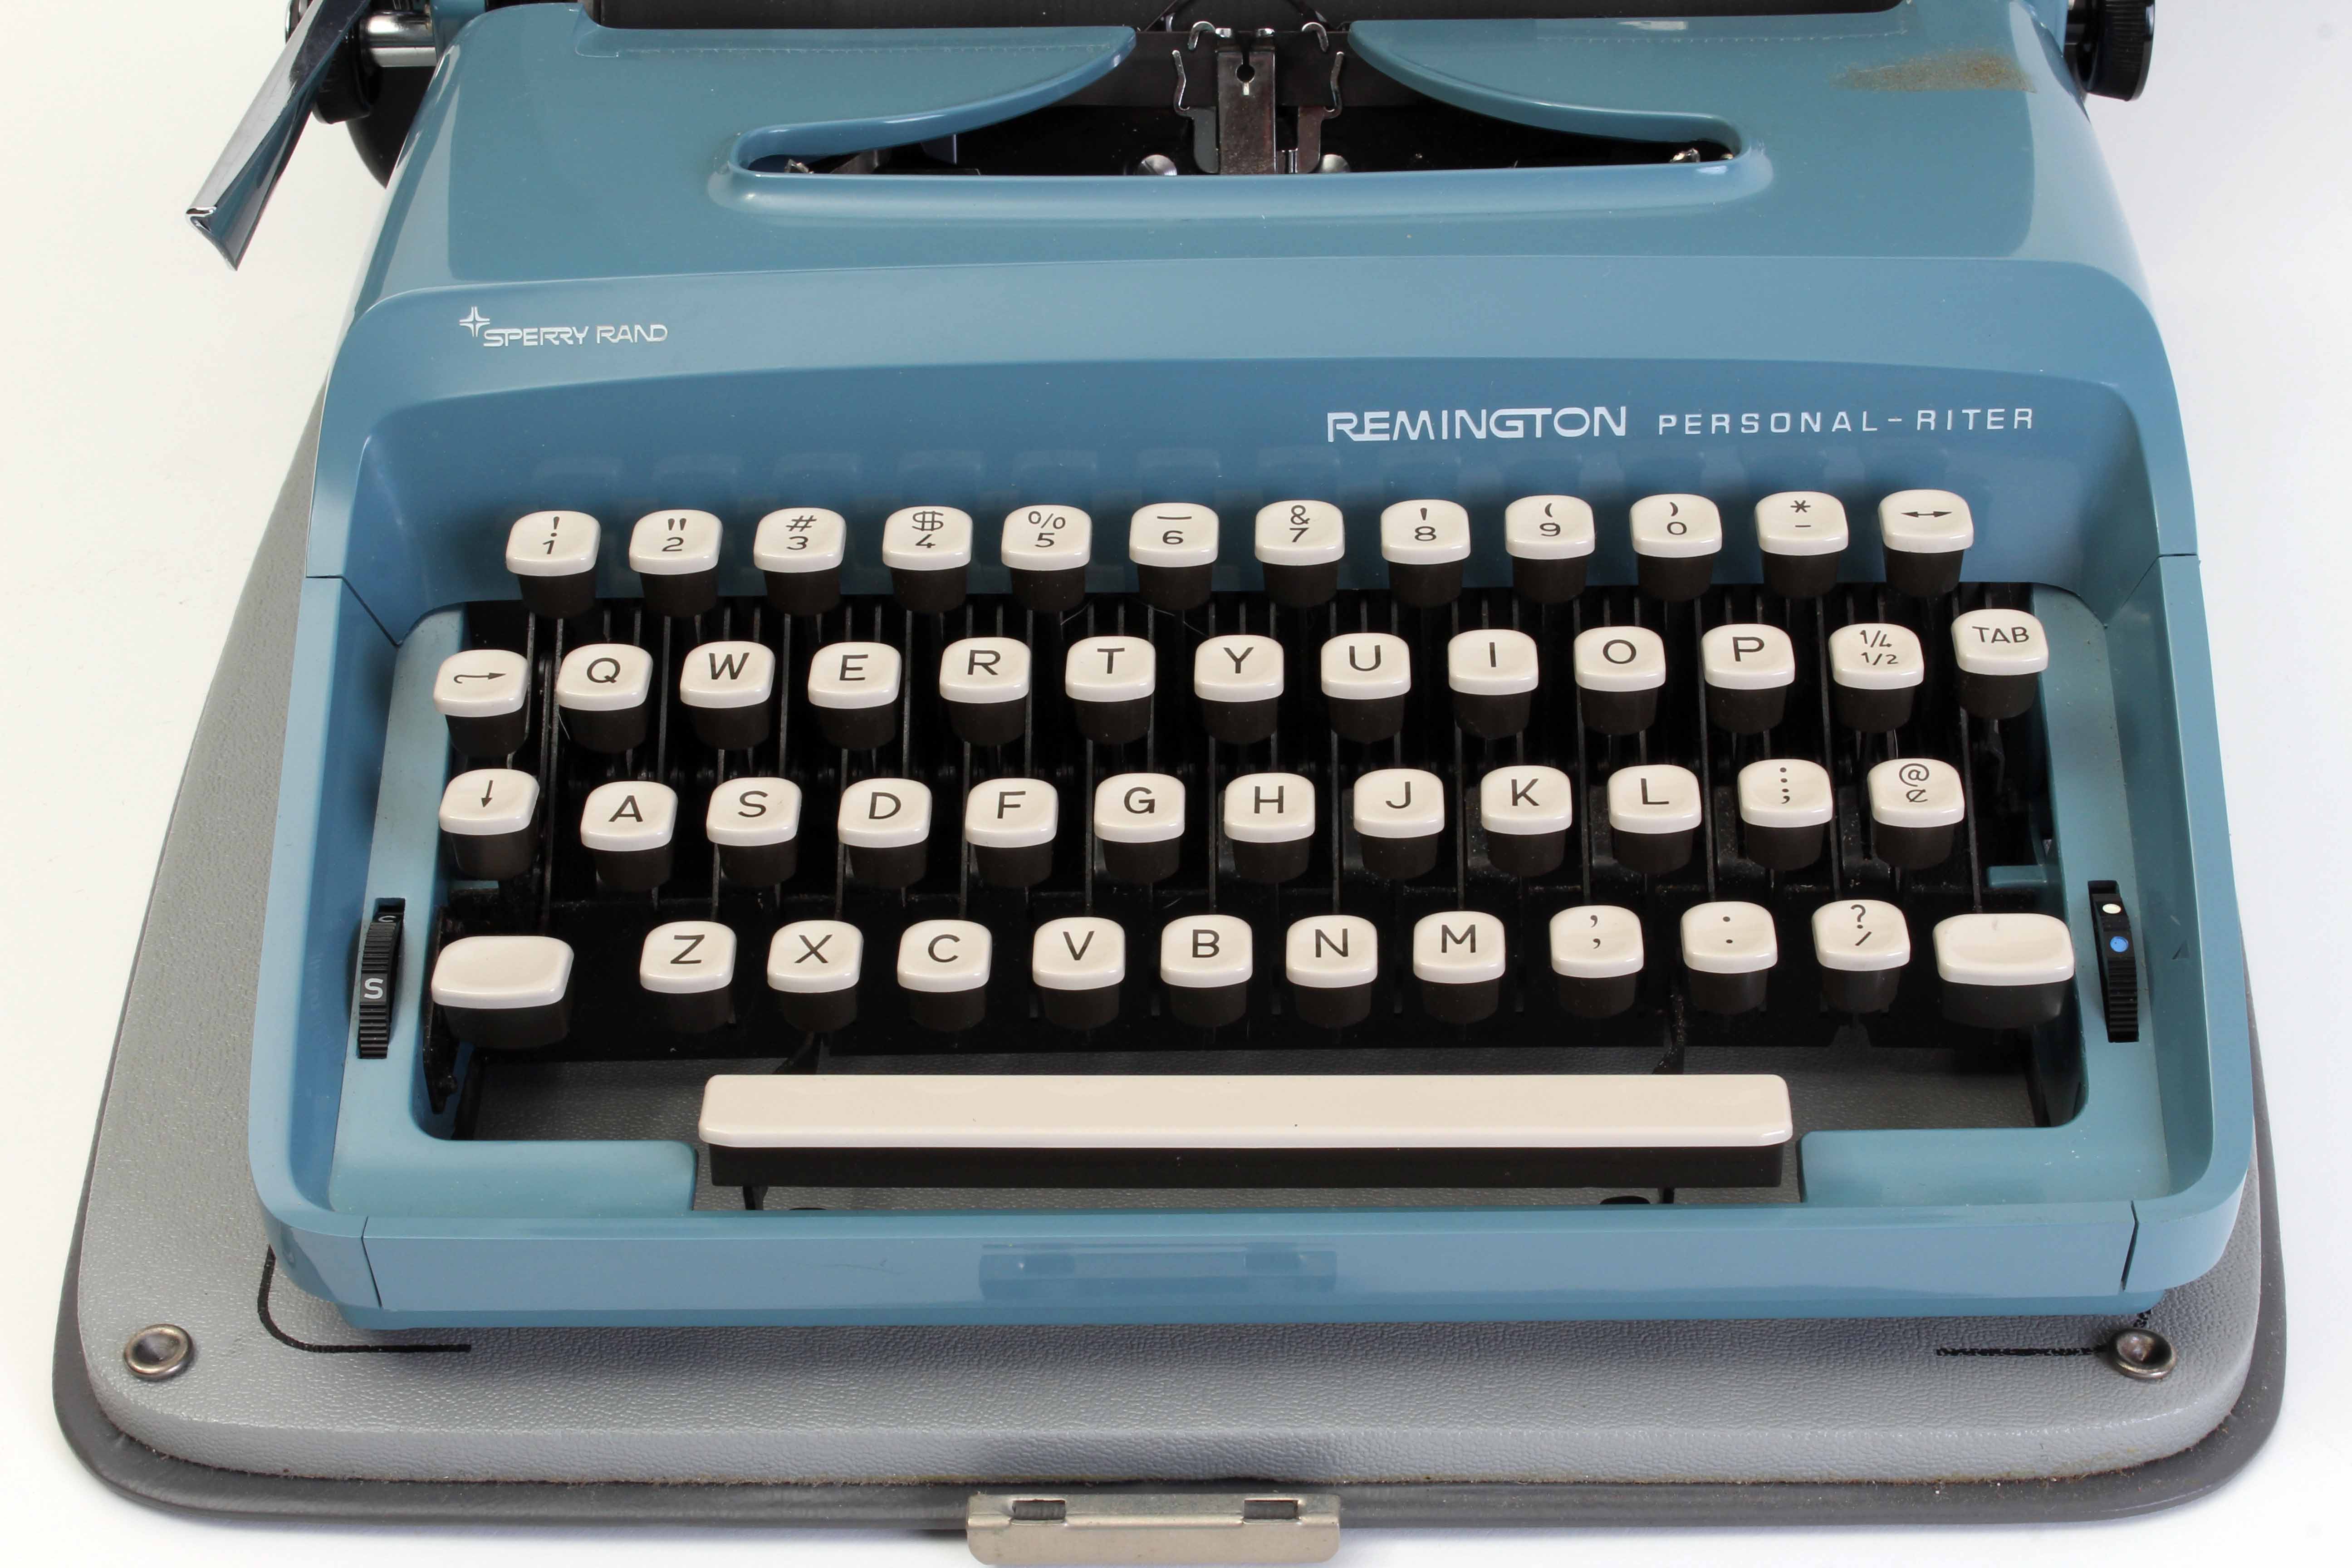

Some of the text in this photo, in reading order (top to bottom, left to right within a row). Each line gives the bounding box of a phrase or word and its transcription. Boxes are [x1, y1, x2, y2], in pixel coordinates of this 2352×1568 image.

[483, 324, 668, 347] SPERRY RAND
[1327, 406, 2033, 442] REMINGTON PERSONAL-RITER
[911, 510, 944, 532] $
[1028, 510, 1066, 530] %
[1290, 505, 1311, 525] &
[1544, 503, 1553, 518] (
[1669, 501, 1679, 517] )
[785, 514, 817, 533] #
[1289, 527, 1309, 543] 7
[1414, 525, 1437, 542] 8
[1539, 522, 1561, 537] 9
[542, 539, 555, 555] 1
[661, 536, 684, 552] 2
[786, 535, 809, 551] 3
[915, 534, 936, 549] 4
[1034, 532, 1055, 548] 5
[1162, 529, 1184, 545] 6
[1859, 629, 1892, 648] 1/4
[1972, 626, 2030, 644] TAB
[1097, 647, 1125, 675] T
[1223, 647, 1254, 674] Y
[1348, 644, 1382, 672] U
[1489, 642, 1497, 668] I
[1602, 639, 1637, 665] O
[1732, 636, 1765, 662] P
[1861, 652, 1899, 666] 1/2
[586, 657, 621, 684] Q
[708, 652, 750, 681] W
[838, 654, 869, 681] E
[967, 649, 1001, 676] R
[1898, 763, 1930, 788] @
[737, 790, 769, 818] S
[996, 790, 1026, 819] F
[1123, 786, 1156, 814] G
[1254, 785, 1284, 814] H
[1385, 781, 1411, 809] J
[1511, 778, 1540, 807] K
[1640, 778, 1670, 805] L
[608, 795, 644, 823] A
[868, 791, 902, 820] D
[1850, 904, 1866, 930] ?
[670, 934, 706, 965] Z
[794, 934, 833, 964] X
[927, 934, 960, 963] C
[1063, 930, 1095, 961] V
[1191, 929, 1220, 959] B
[1315, 928, 1349, 958] N
[1441, 924, 1477, 954] M
[1854, 931, 1872, 947] /
[363, 977, 384, 1000] S
